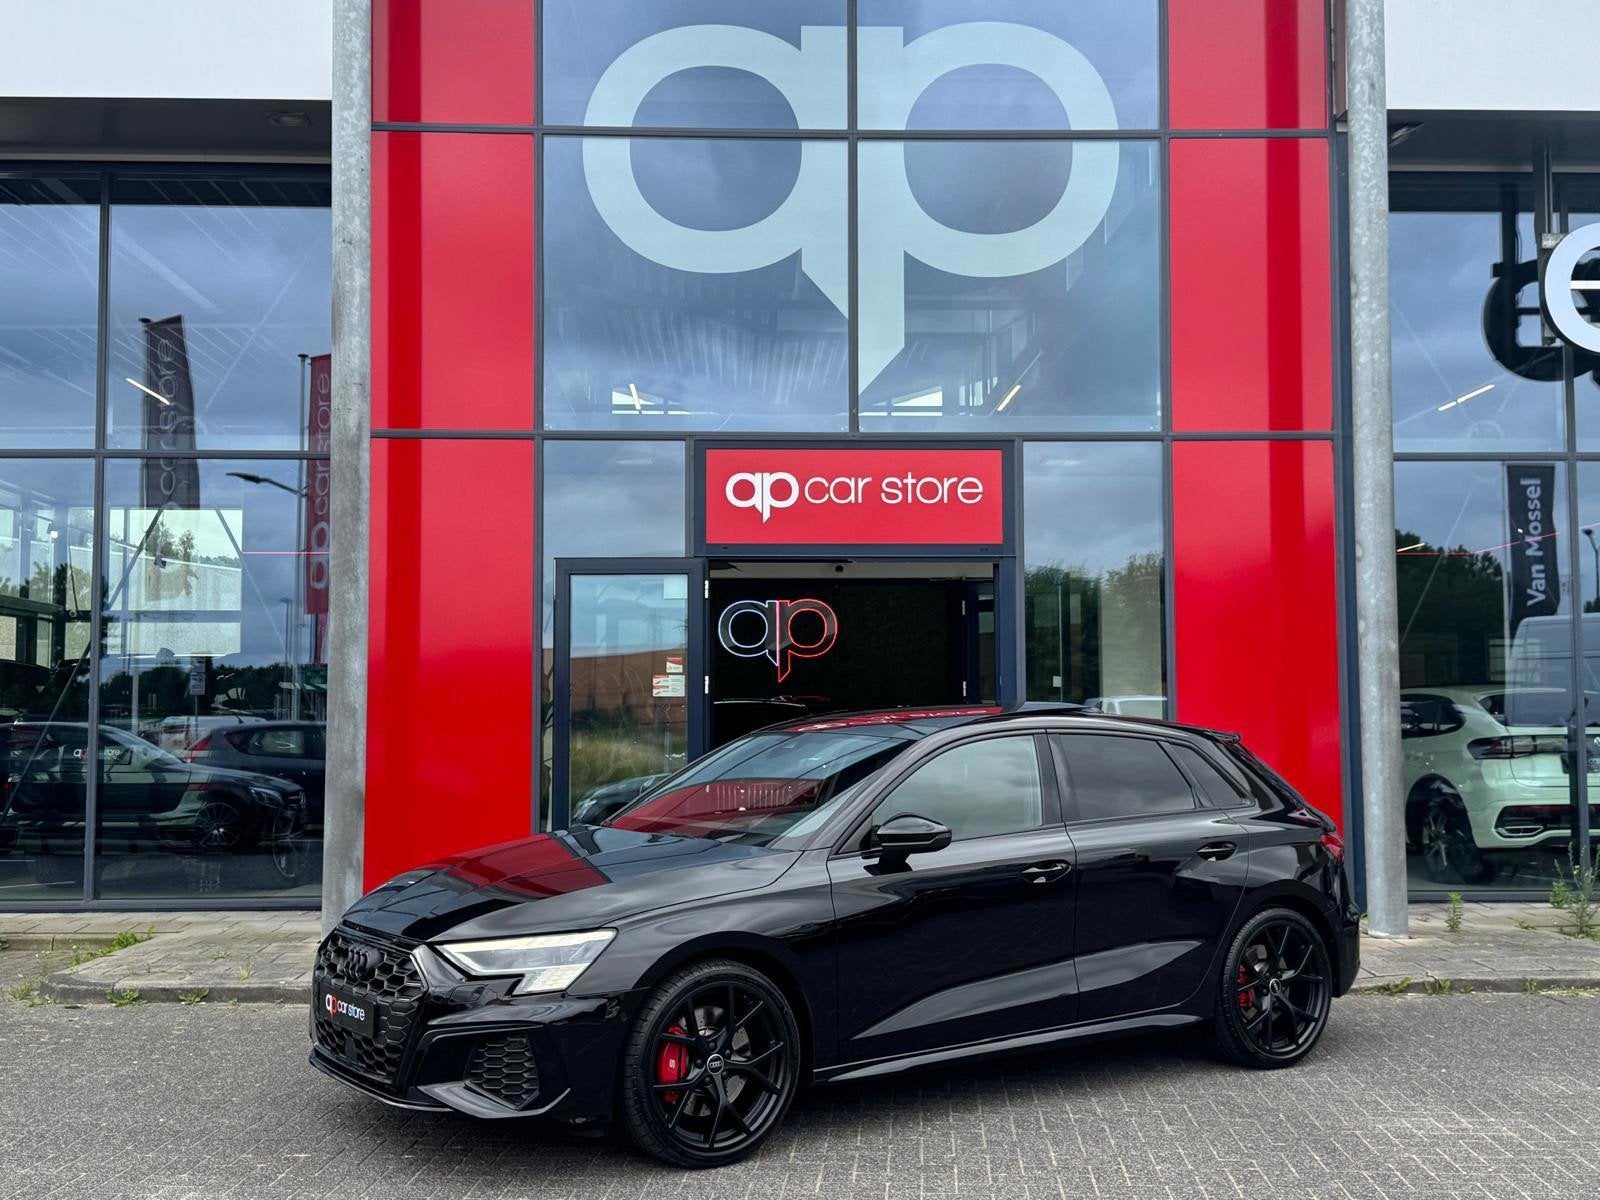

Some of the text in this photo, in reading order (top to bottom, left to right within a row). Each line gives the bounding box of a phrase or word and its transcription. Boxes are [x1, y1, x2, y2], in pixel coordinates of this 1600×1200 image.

[582, 21, 1120, 395] ap
[725, 471, 983, 524] ap car store
[1520, 478, 1546, 607] Van Mossel
[718, 598, 838, 683] ap
[325, 993, 365, 1021] ap car store
